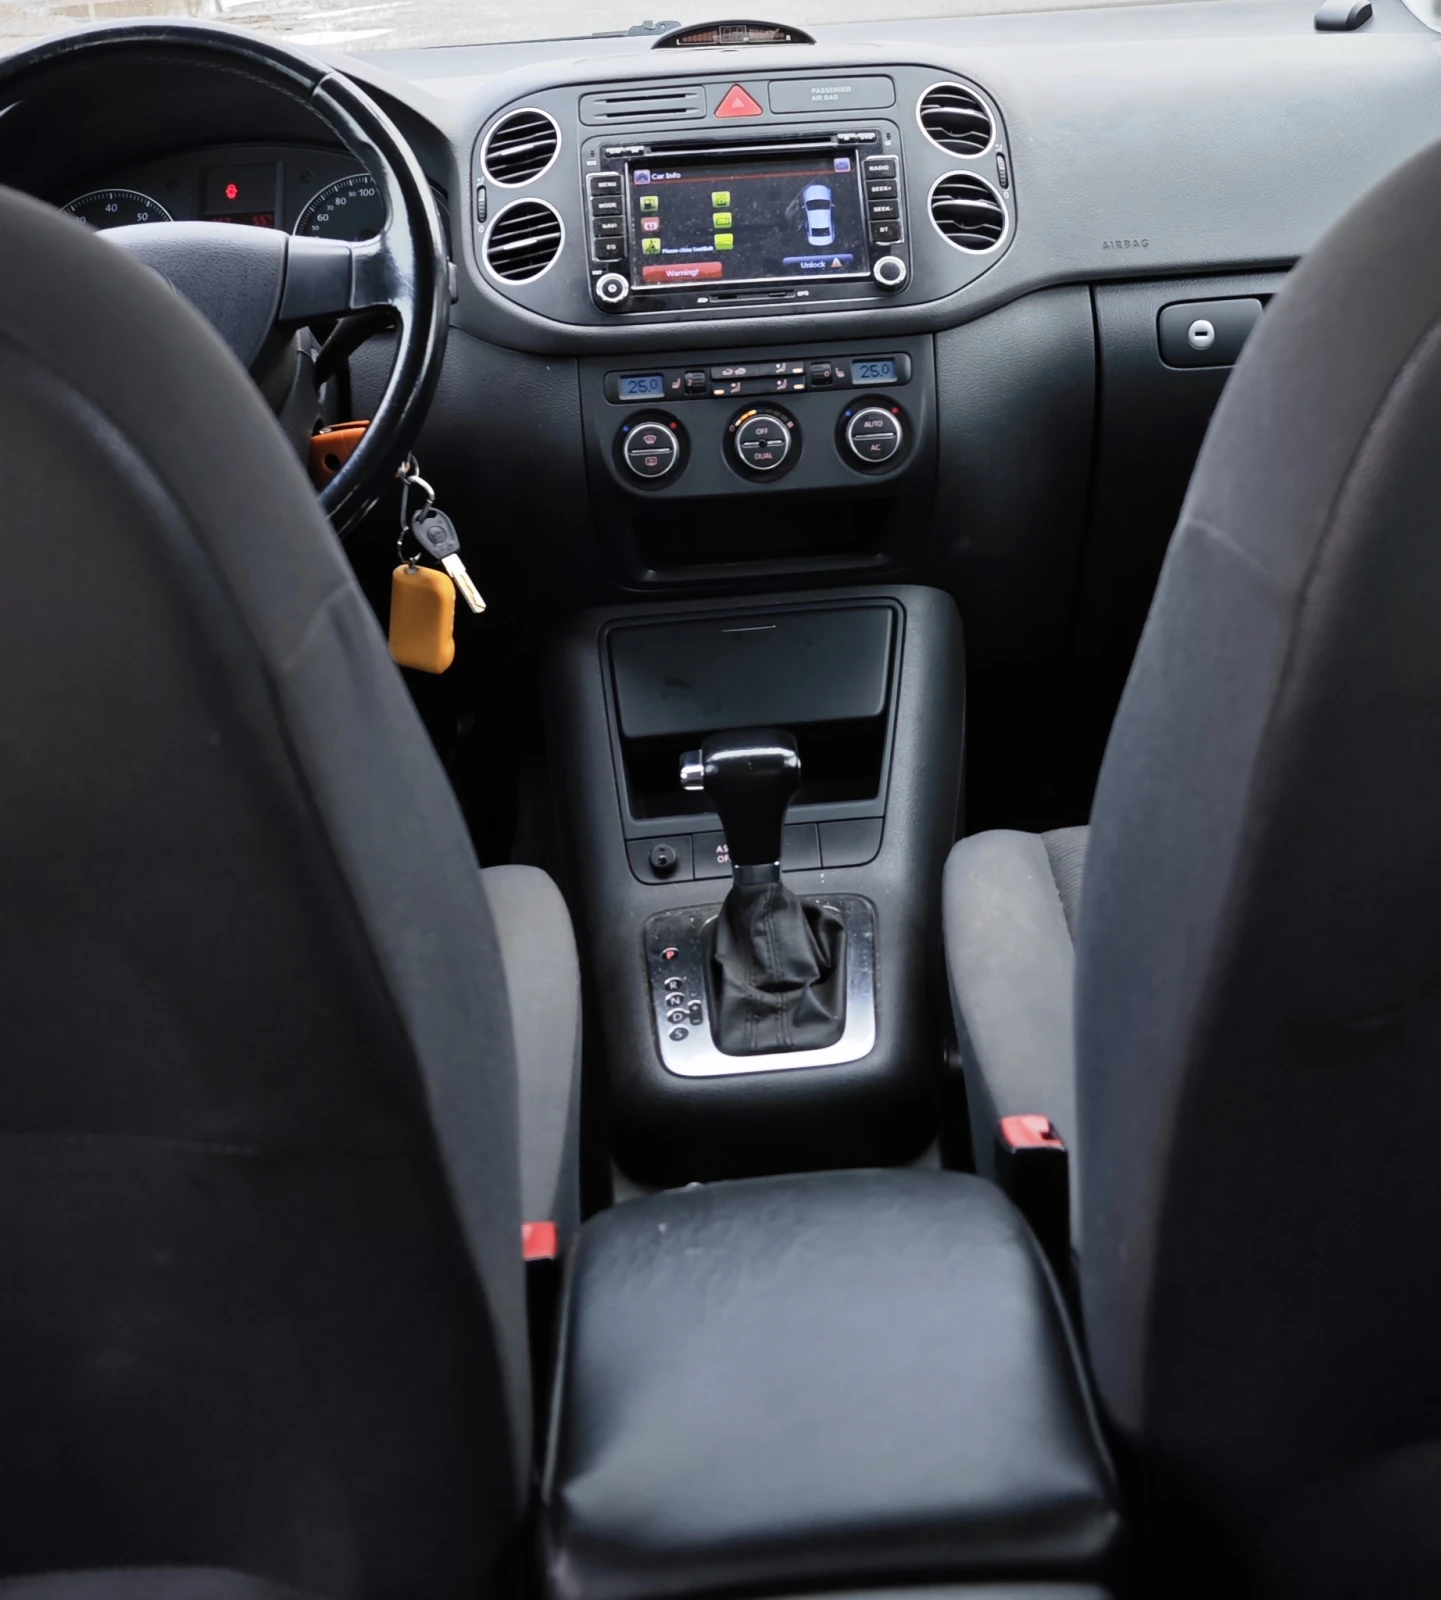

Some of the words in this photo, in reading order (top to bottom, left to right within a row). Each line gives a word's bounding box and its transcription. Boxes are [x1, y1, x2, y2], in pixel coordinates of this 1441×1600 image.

[811, 86, 852, 94] PASSENGER
[358, 188, 375, 197] 100
[335, 197, 347, 206] 80
[105, 203, 118, 212] 40
[136, 212, 149, 222] 50
[317, 213, 329, 222] 60
[1102, 239, 1149, 249] AIRBAG
[800, 261, 826, 269] Unlock
[859, 363, 890, 379] 25.0
[627, 379, 658, 394] 25.0
[863, 420, 883, 428] AUTO
[754, 452, 774, 460] DUAL
[716, 844, 729, 853] AS
[669, 981, 678, 990] R
[670, 997, 681, 1005] N
[672, 1013, 683, 1021] D
[675, 1029, 684, 1039] S
